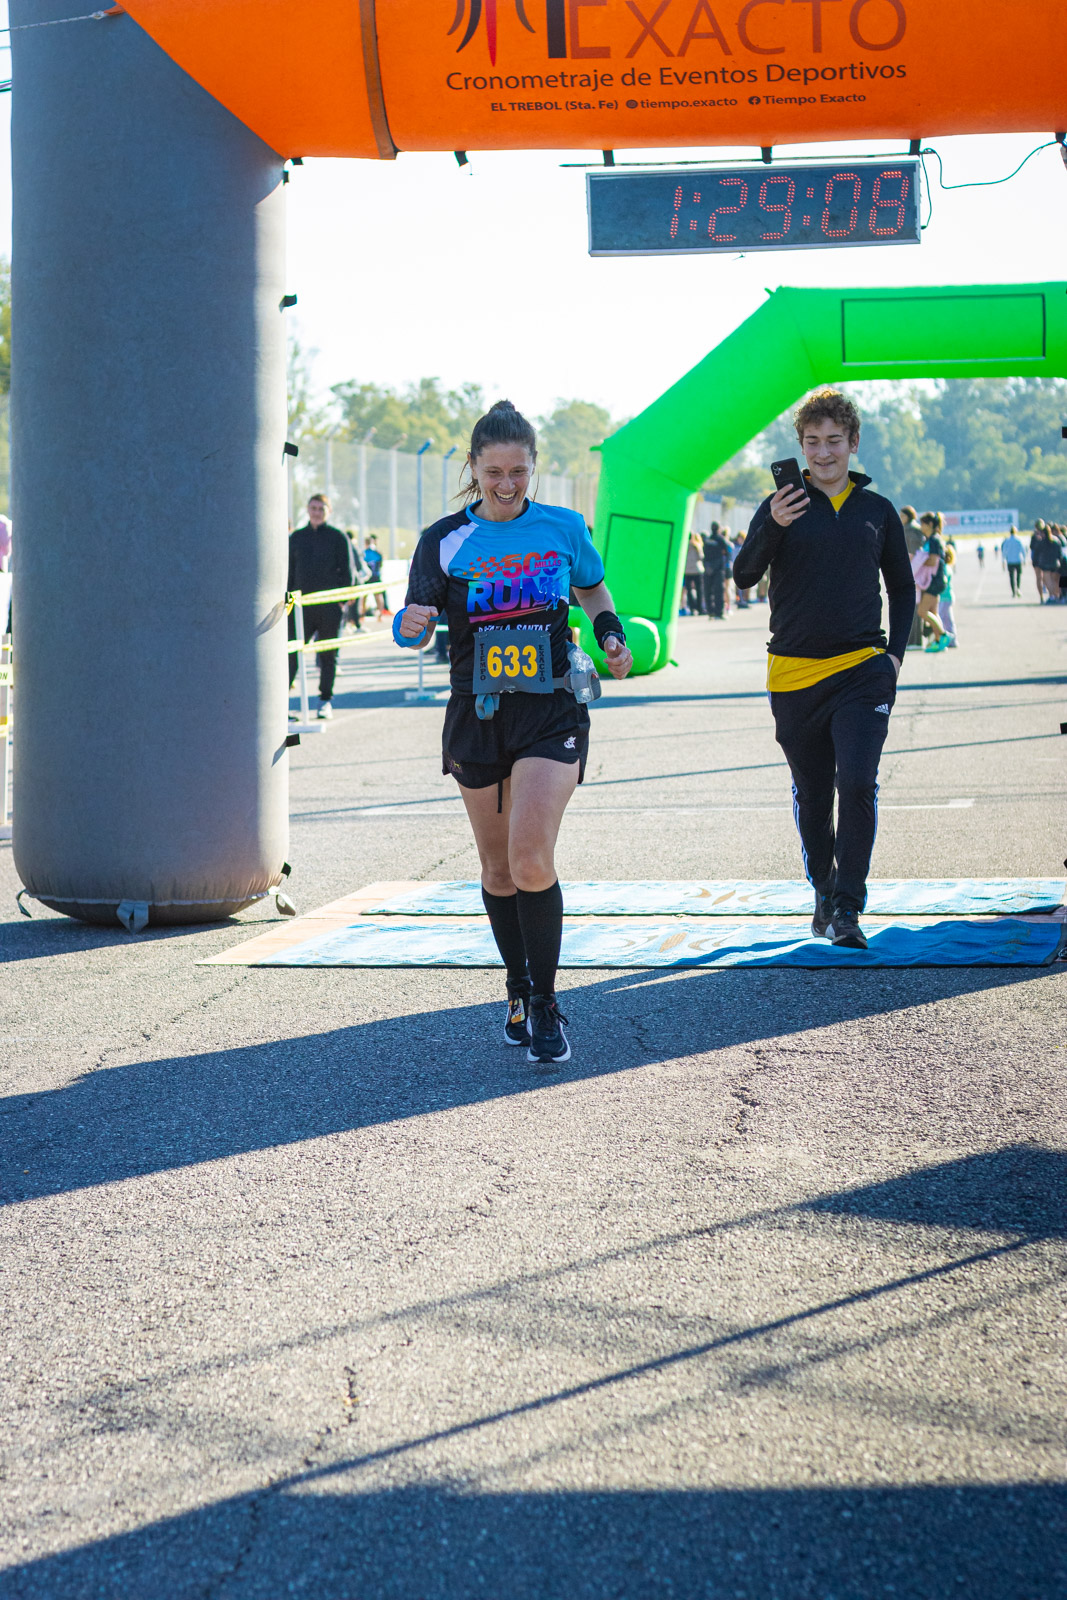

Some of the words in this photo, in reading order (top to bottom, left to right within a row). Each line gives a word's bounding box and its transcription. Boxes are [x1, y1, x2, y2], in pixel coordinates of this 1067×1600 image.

[446, 69, 614, 92] Cronometraje
[621, 67, 651, 86] de
[660, 66, 758, 86] Eventos
[766, 62, 907, 85] Deportivos
[491, 102, 507, 111] EL
[508, 101, 562, 111] TREBOL
[565, 100, 596, 111] (Sta.
[598, 99, 619, 111] Fe)
[640, 97, 738, 110] tiempo.exacto
[763, 95, 817, 105] Tiempo
[820, 93, 867, 104] Exacto
[669, 170, 910, 242] 1:29:08
[534, 559, 562, 569] MILLAS
[479, 643, 487, 681] TIEMPO
[487, 644, 538, 678] 633
[538, 644, 546, 683] EXACTO
